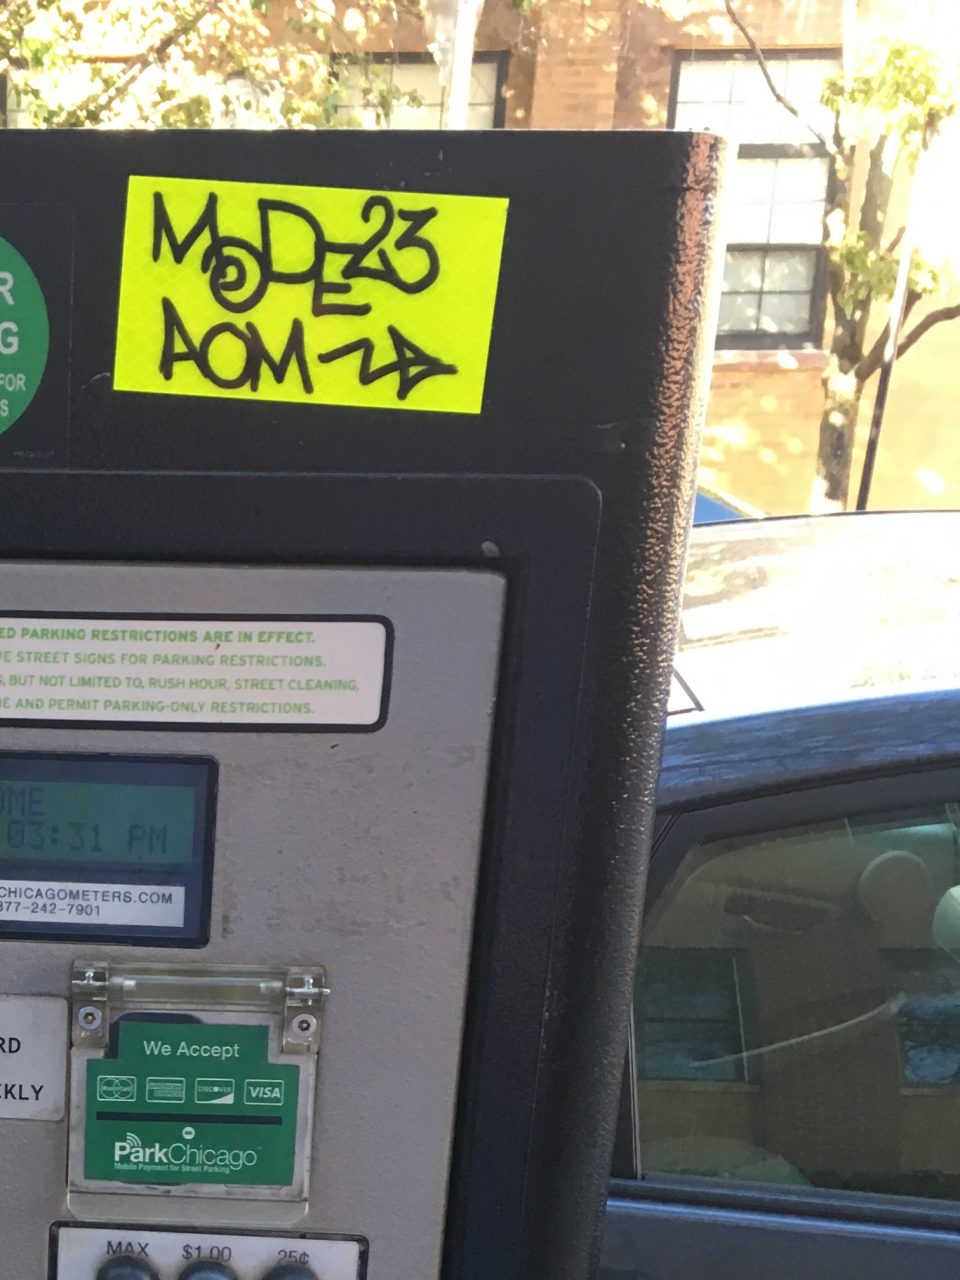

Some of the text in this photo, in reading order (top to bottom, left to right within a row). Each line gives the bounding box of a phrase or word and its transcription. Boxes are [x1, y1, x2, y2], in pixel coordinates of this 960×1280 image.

[21, 627, 86, 641] PARKING
[92, 629, 197, 642] RESTRICTIONS
[203, 629, 233, 643] ARE
[238, 630, 252, 643] IN
[258, 630, 315, 644] EFFECT.
[128, 825, 168, 854] PM
[144, 1040, 239, 1060] We Accept
[249, 1087, 281, 1098] VISA
[114, 1142, 257, 1170] ParkChicago
[107, 1240, 149, 1257] MAX
